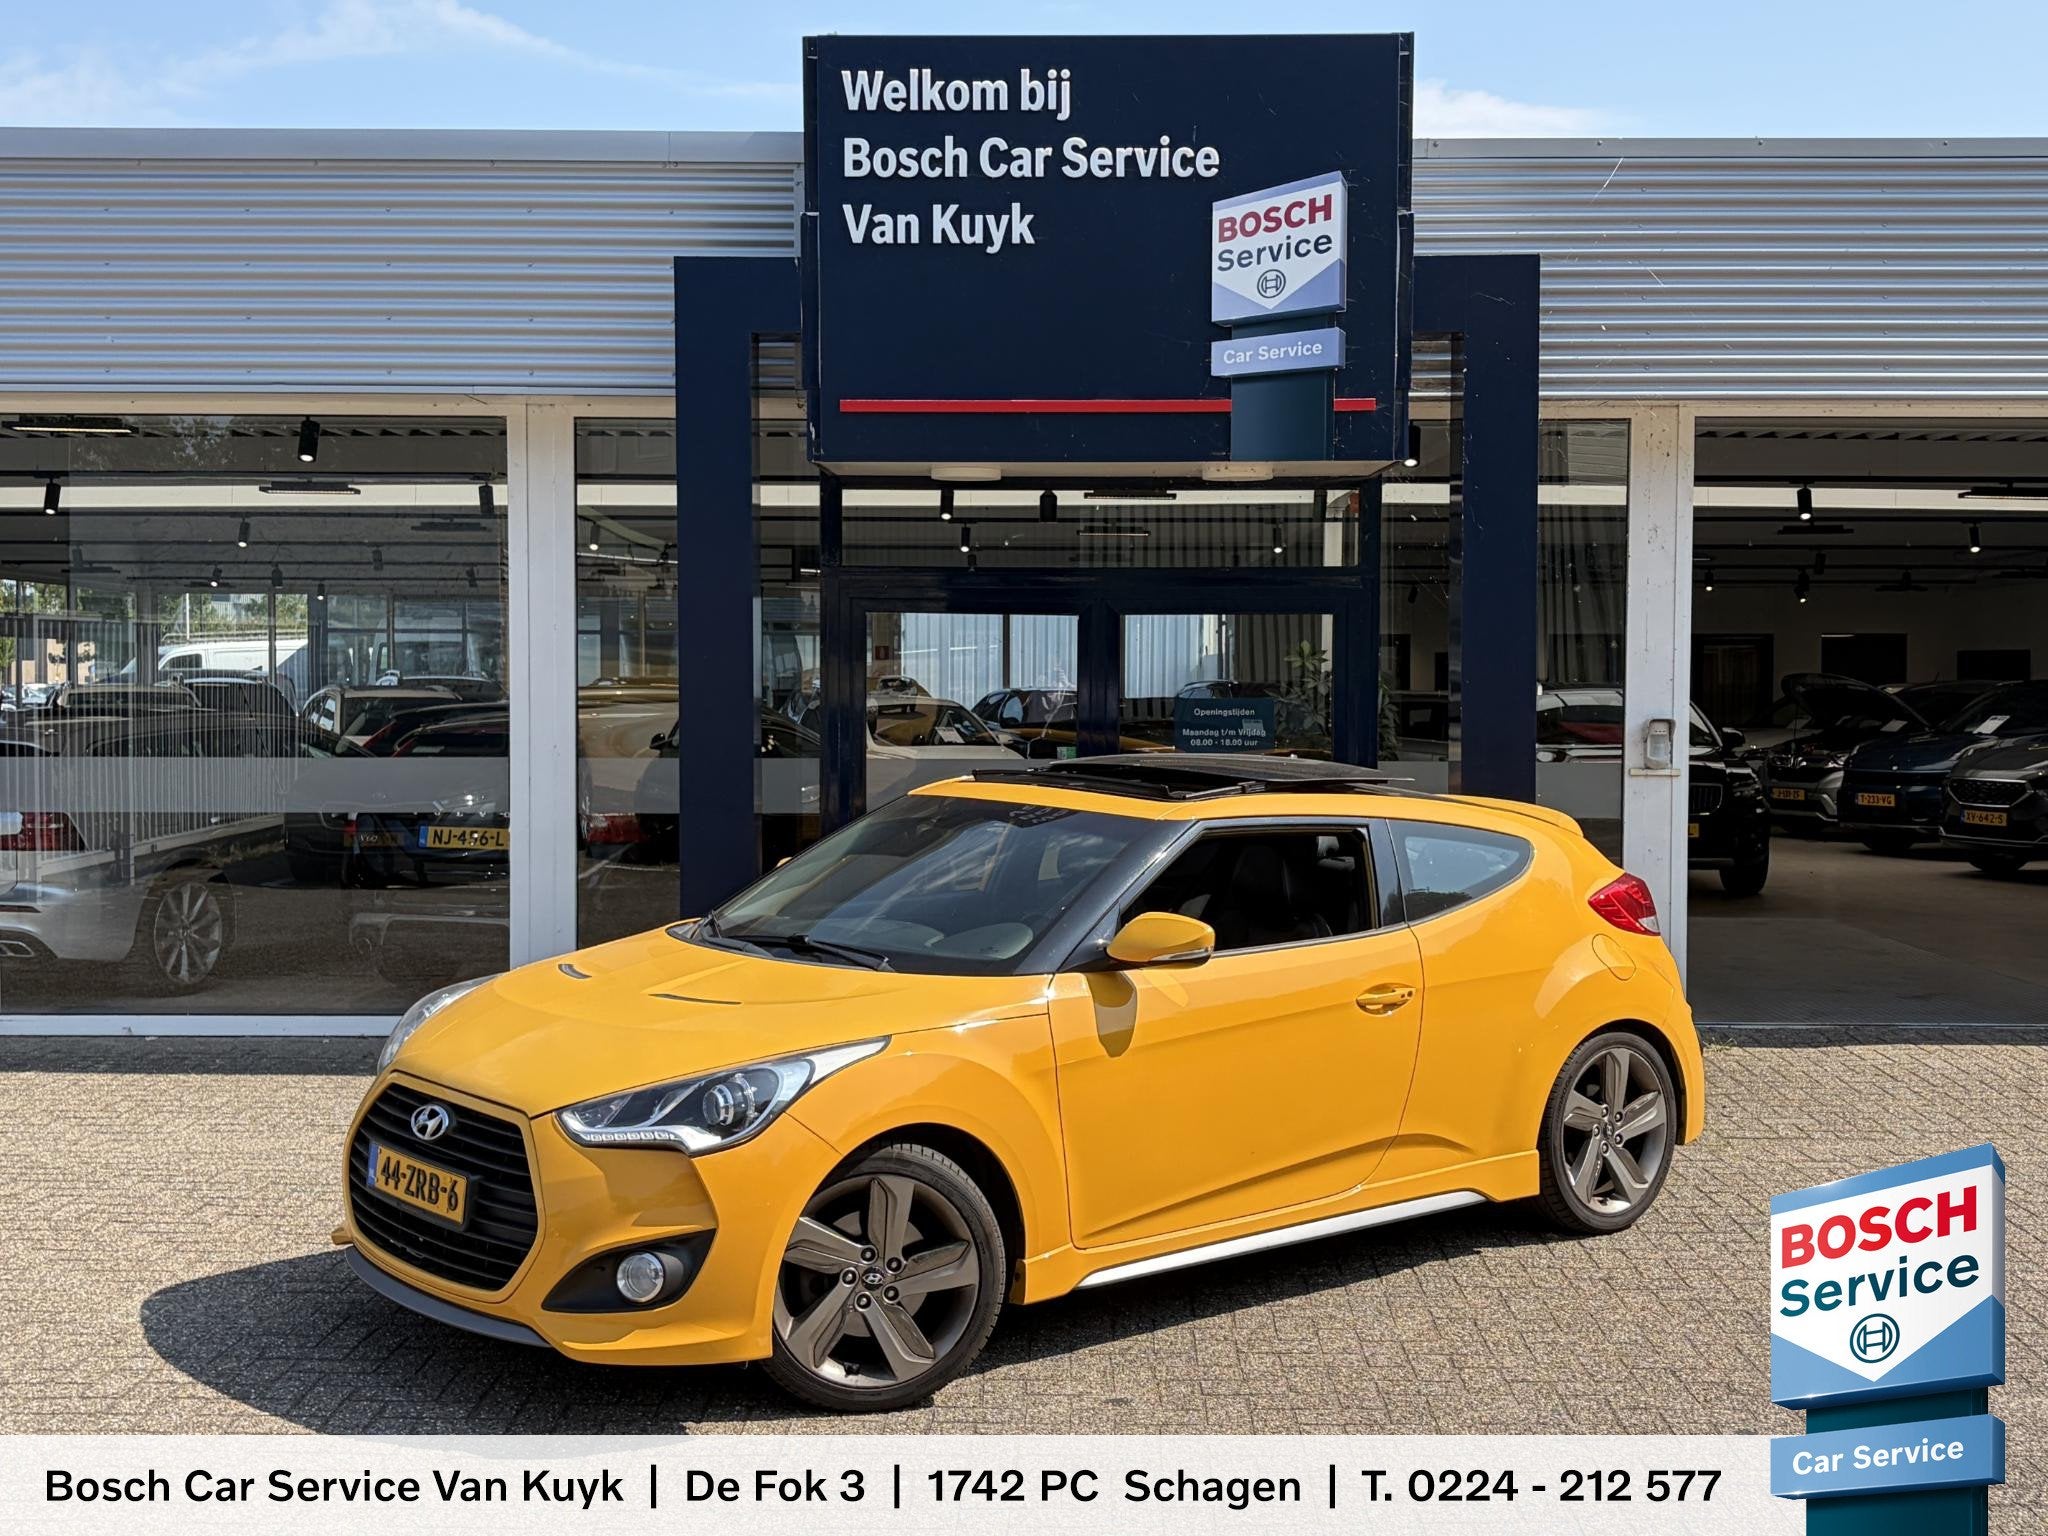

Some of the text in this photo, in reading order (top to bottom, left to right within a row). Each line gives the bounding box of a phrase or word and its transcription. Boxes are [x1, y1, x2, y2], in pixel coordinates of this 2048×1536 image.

[841, 69, 1071, 120] Welkom bij
[843, 135, 1220, 178] Bosch Car Service
[842, 203, 1035, 254] Van Kuyk
[1218, 194, 1332, 243] BOSCH
[1217, 234, 1332, 272] Service
[1223, 341, 1322, 364] Car Service
[1182, 728, 1266, 737] Maandag t/m Vrijdag
[1193, 707, 1256, 717] Openingstijden
[381, 1156, 459, 1211] 44-ZRB-6
